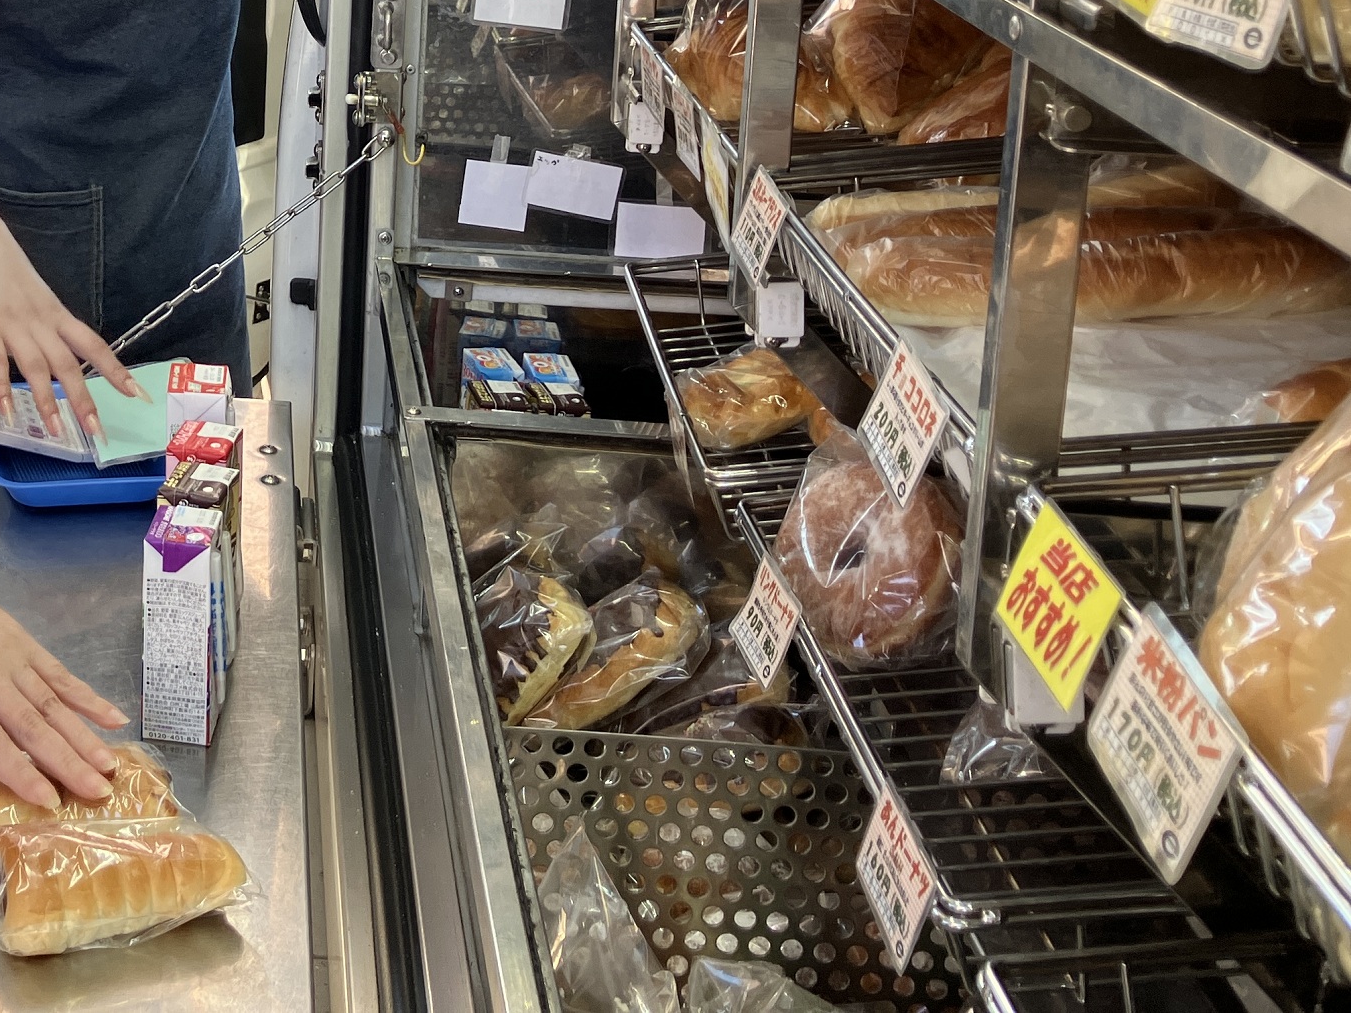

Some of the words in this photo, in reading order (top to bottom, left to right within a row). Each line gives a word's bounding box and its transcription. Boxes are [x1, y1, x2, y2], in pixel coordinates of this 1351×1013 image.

[1006, 567, 1092, 681] おすすめ!
[1040, 538, 1099, 606] 当店
[1137, 636, 1222, 760] 米粉パン
[881, 799, 930, 899] あんドーナツ
